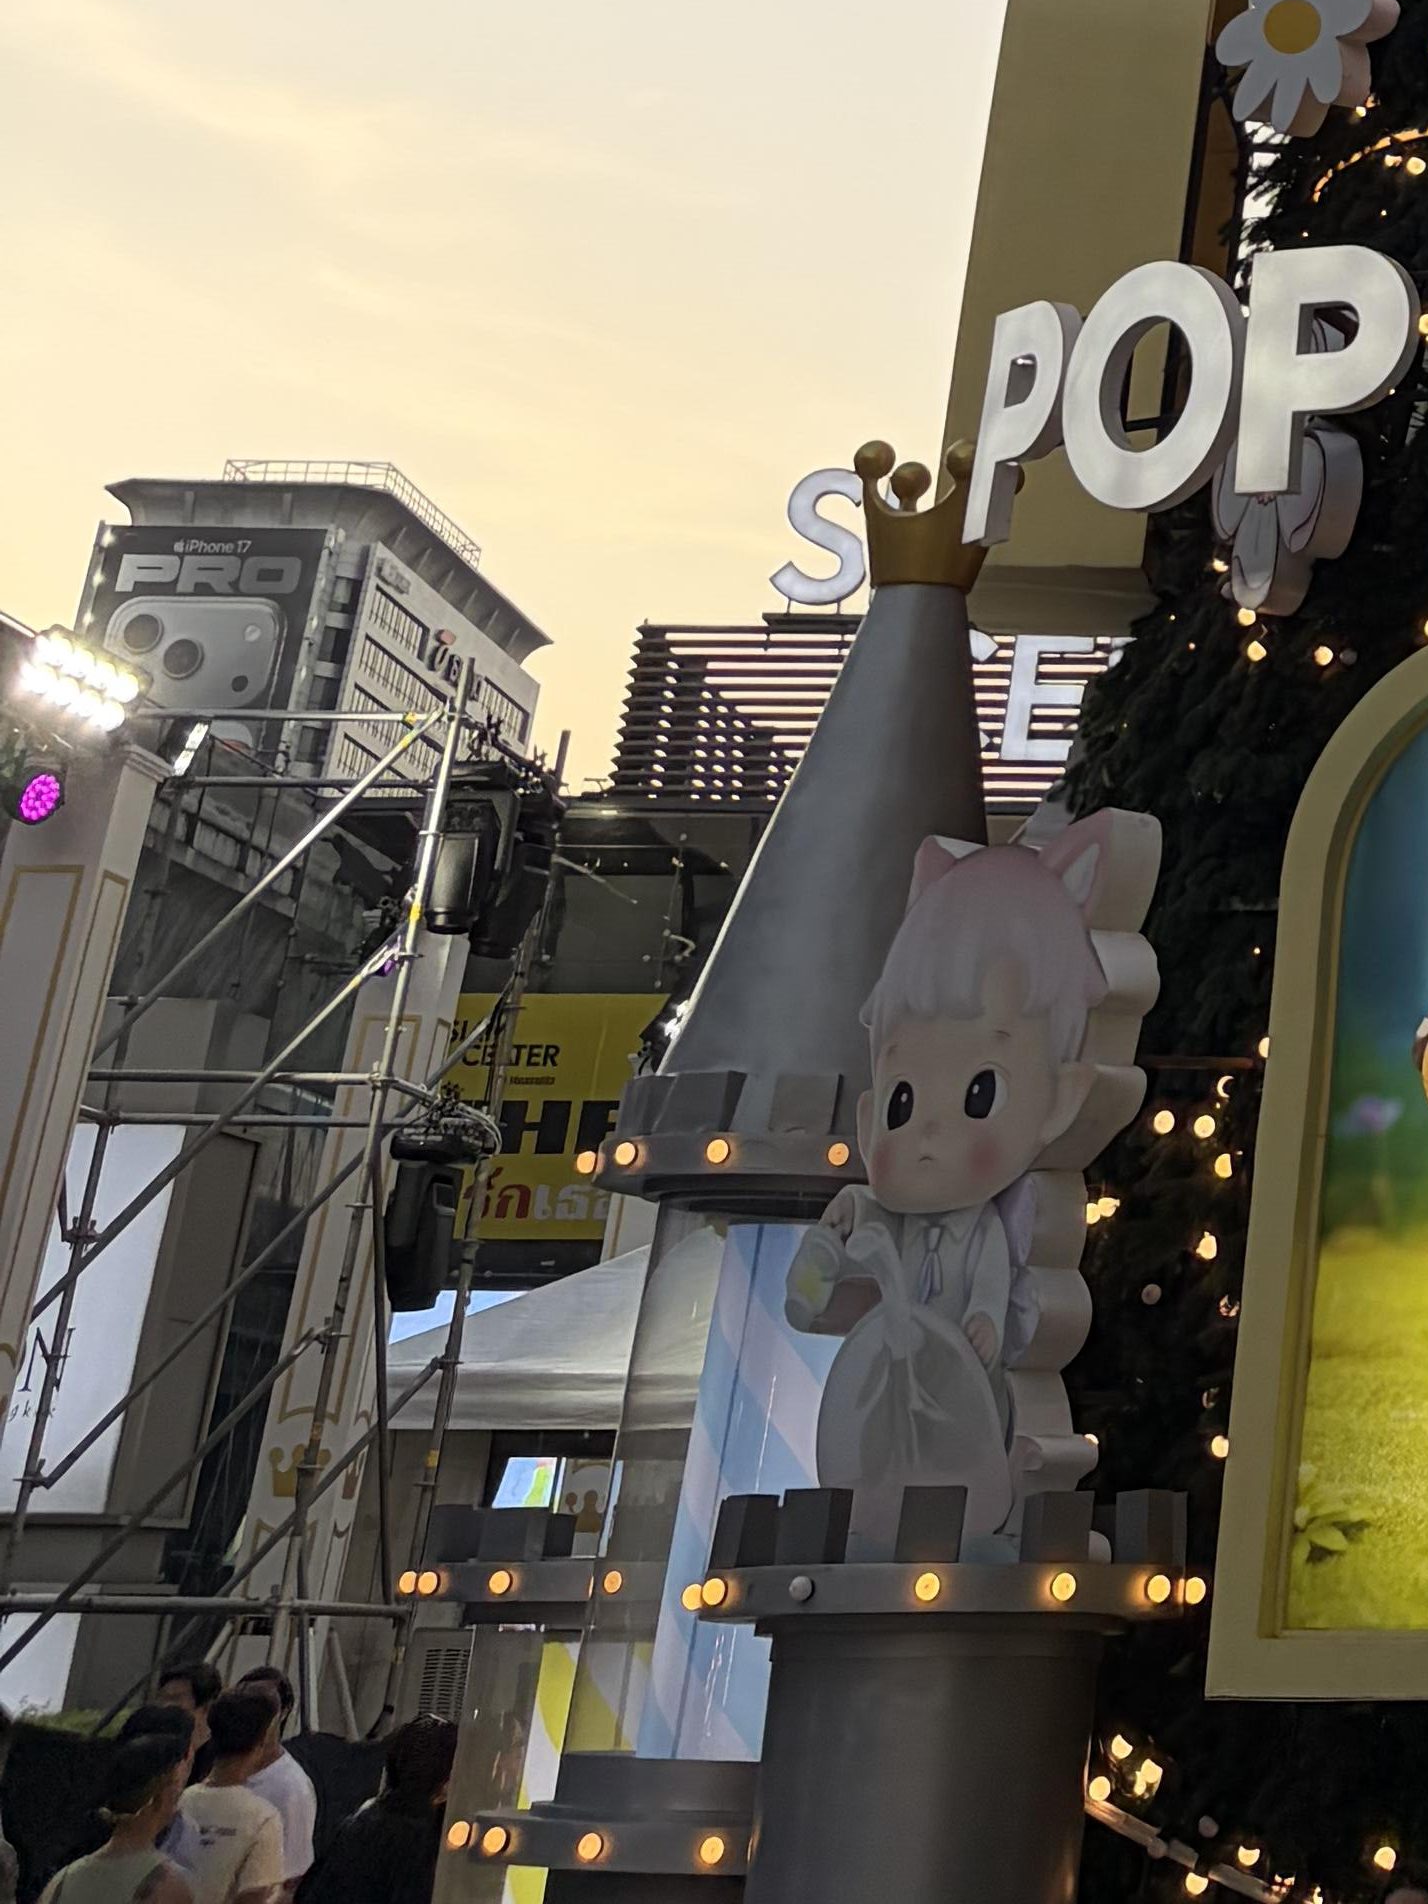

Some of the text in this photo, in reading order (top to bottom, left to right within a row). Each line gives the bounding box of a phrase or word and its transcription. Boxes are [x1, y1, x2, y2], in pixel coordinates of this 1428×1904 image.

[962, 245, 1420, 546] POP
[185, 539, 252, 554] iPhone 17
[115, 555, 302, 592] PRO
